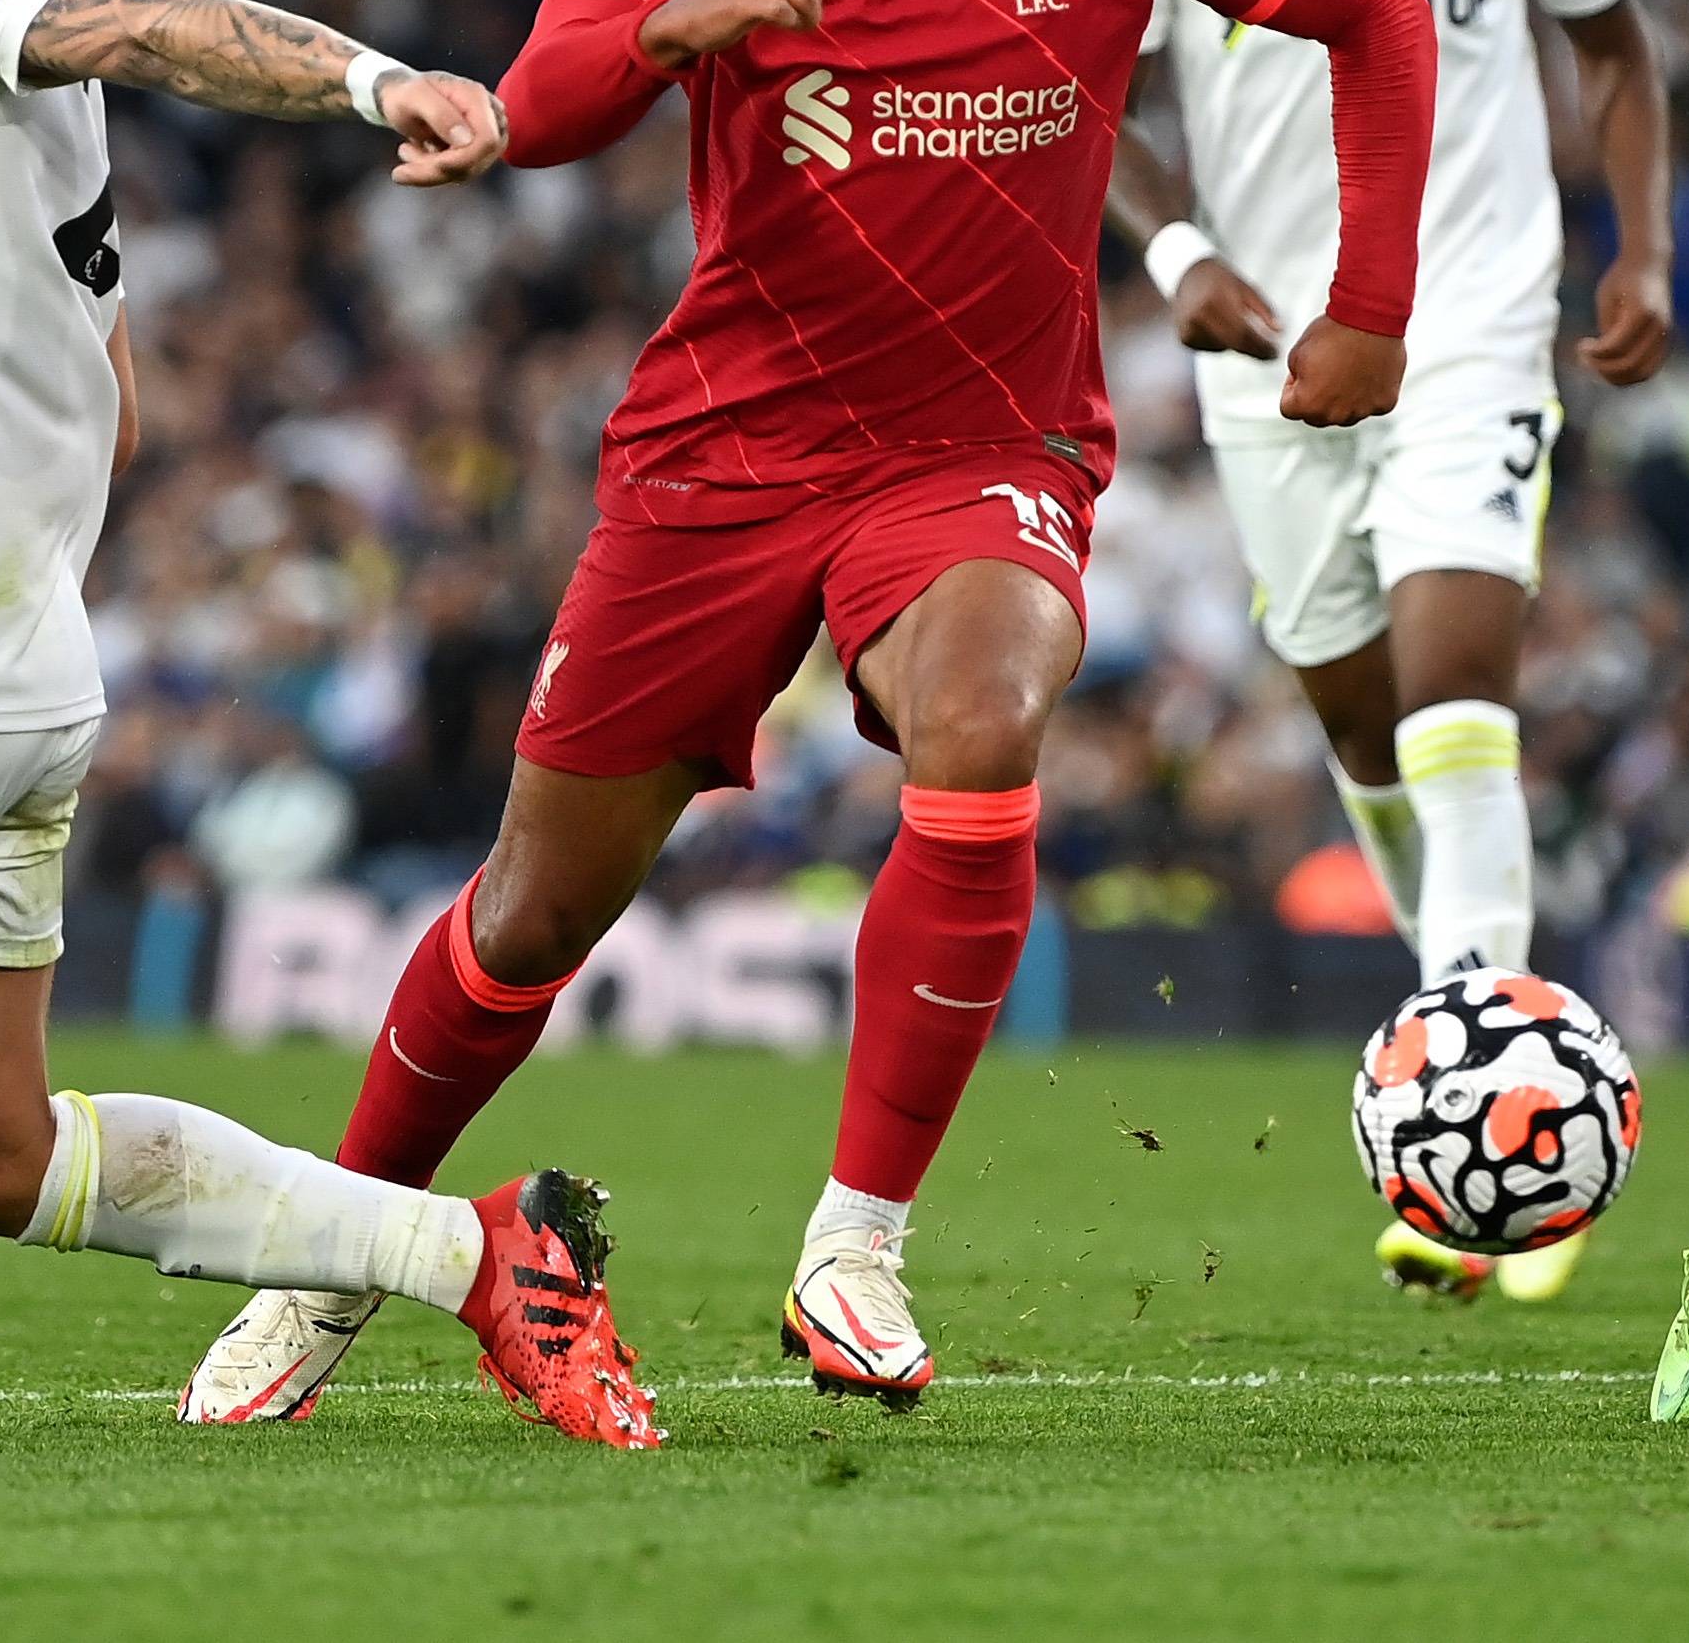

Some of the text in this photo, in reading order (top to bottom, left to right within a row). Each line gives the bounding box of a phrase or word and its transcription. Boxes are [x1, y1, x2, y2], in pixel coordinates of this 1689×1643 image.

[872, 76, 1078, 121] standard
[871, 104, 1079, 158] chartered
[1504, 410, 1542, 480] 3
